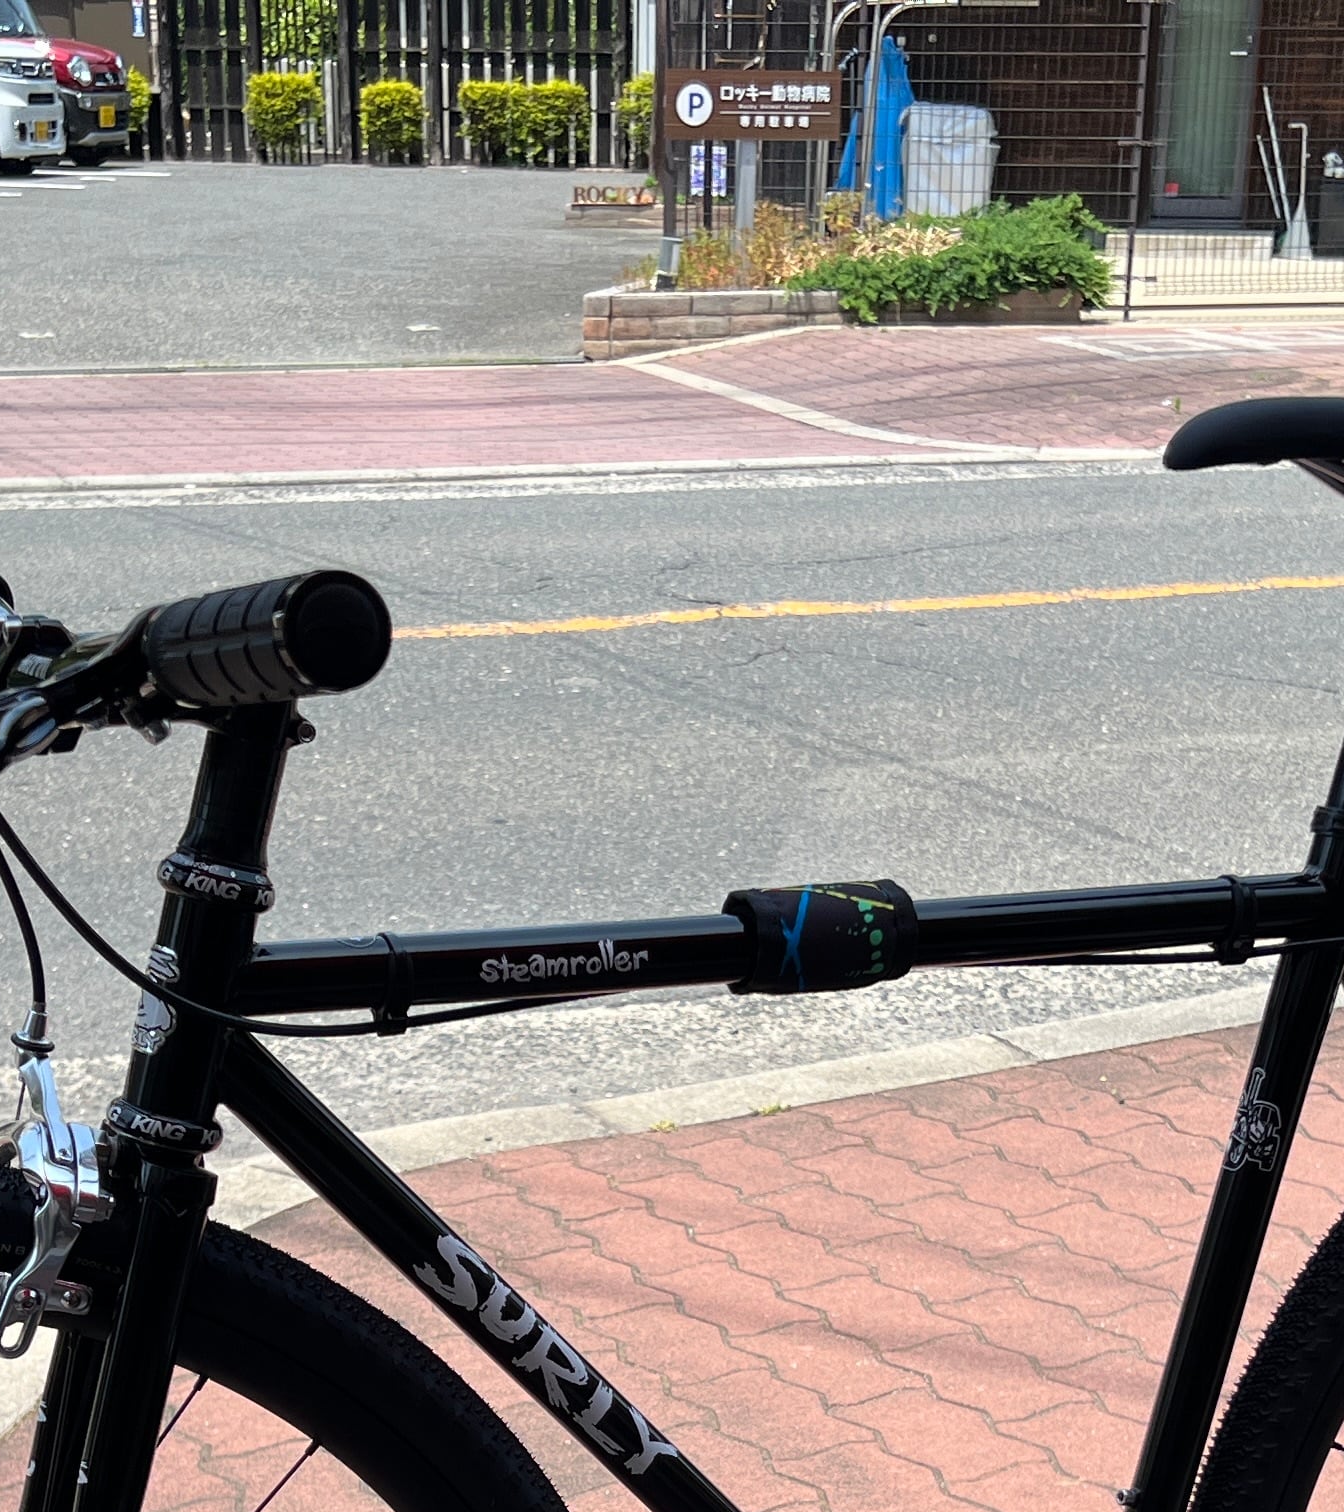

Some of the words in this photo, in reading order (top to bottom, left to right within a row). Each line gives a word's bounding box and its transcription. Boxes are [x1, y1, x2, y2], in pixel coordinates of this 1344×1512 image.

[688, 92, 705, 118] P
[719, 83, 831, 105] ロッキー動物病院
[184, 874, 241, 902] KING
[480, 937, 652, 985] steamroller
[131, 1114, 186, 1142] KING
[413, 1234, 679, 1476] SURLY
